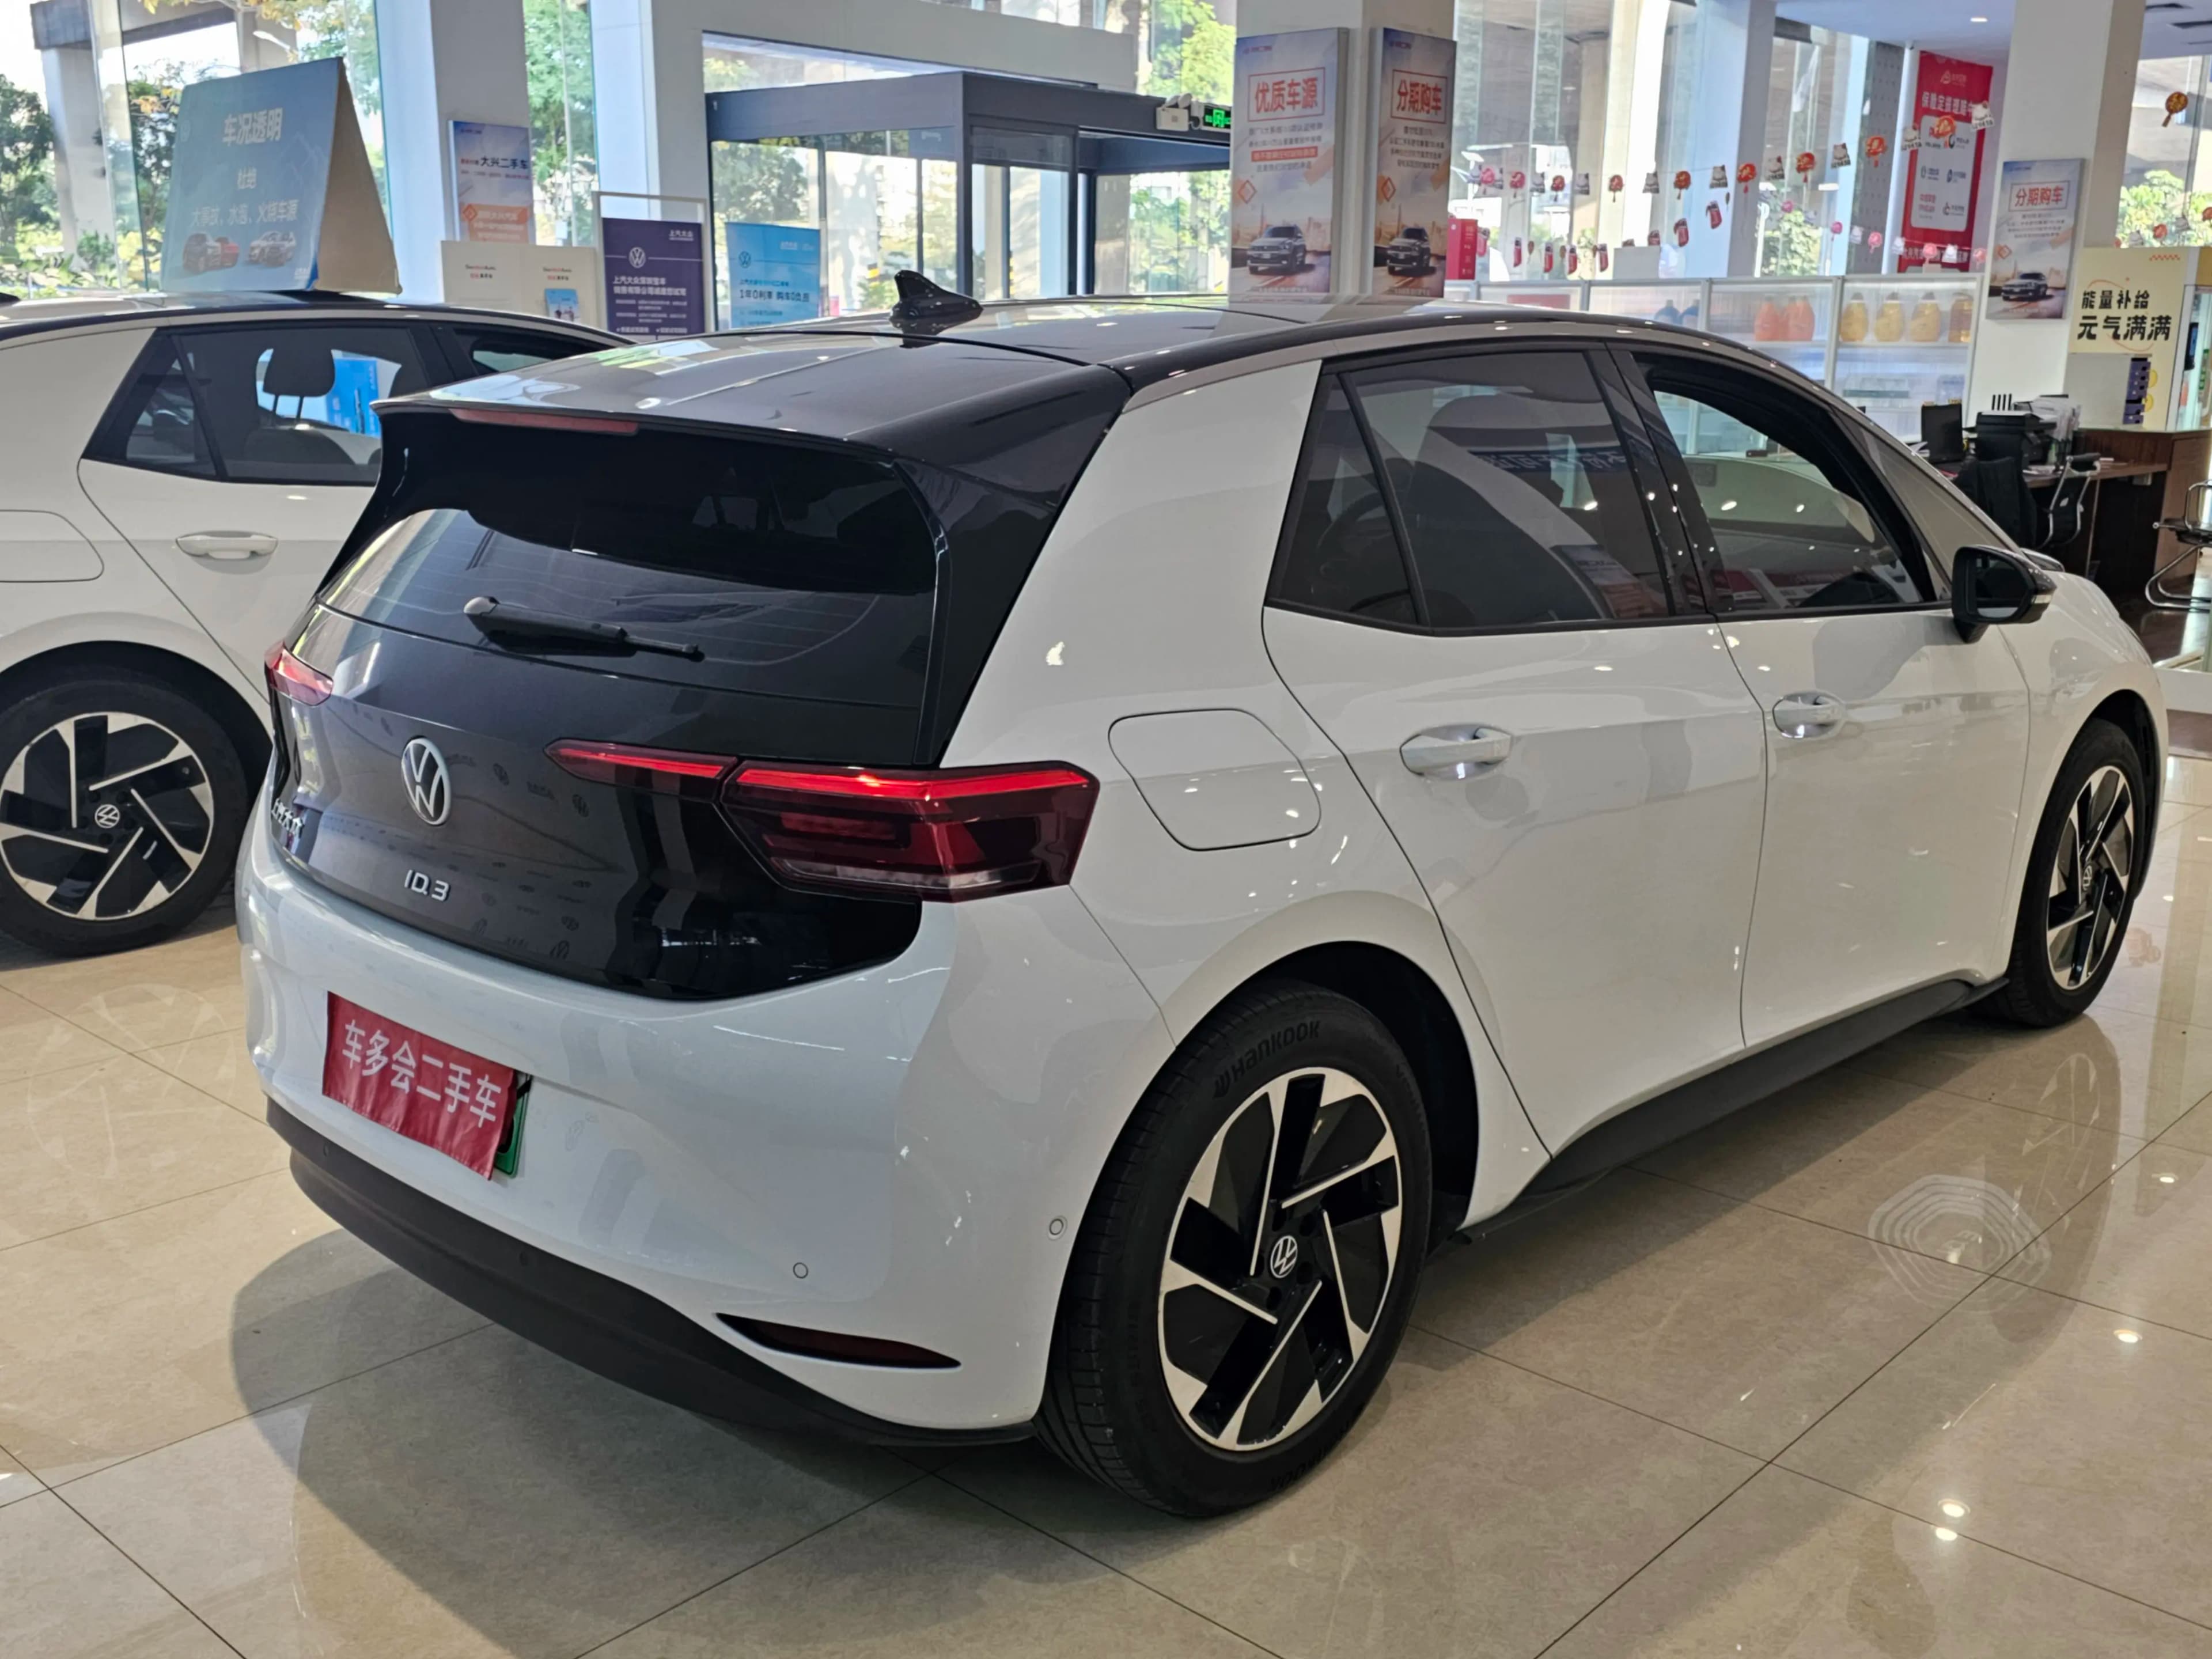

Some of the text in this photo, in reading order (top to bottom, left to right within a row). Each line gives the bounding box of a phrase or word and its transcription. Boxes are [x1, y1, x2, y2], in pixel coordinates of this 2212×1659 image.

[1255, 77, 1318, 113] 优质车源
[1396, 79, 1442, 116] 分期购车
[222, 107, 283, 146] 车况透明
[480, 156, 528, 169] 大兴二手车
[2014, 185, 2065, 207] 分期购车
[2081, 290, 2150, 309] 能量补给
[2077, 315, 2172, 340] 元气满满
[342, 1019, 502, 1128] 车多会二手车
